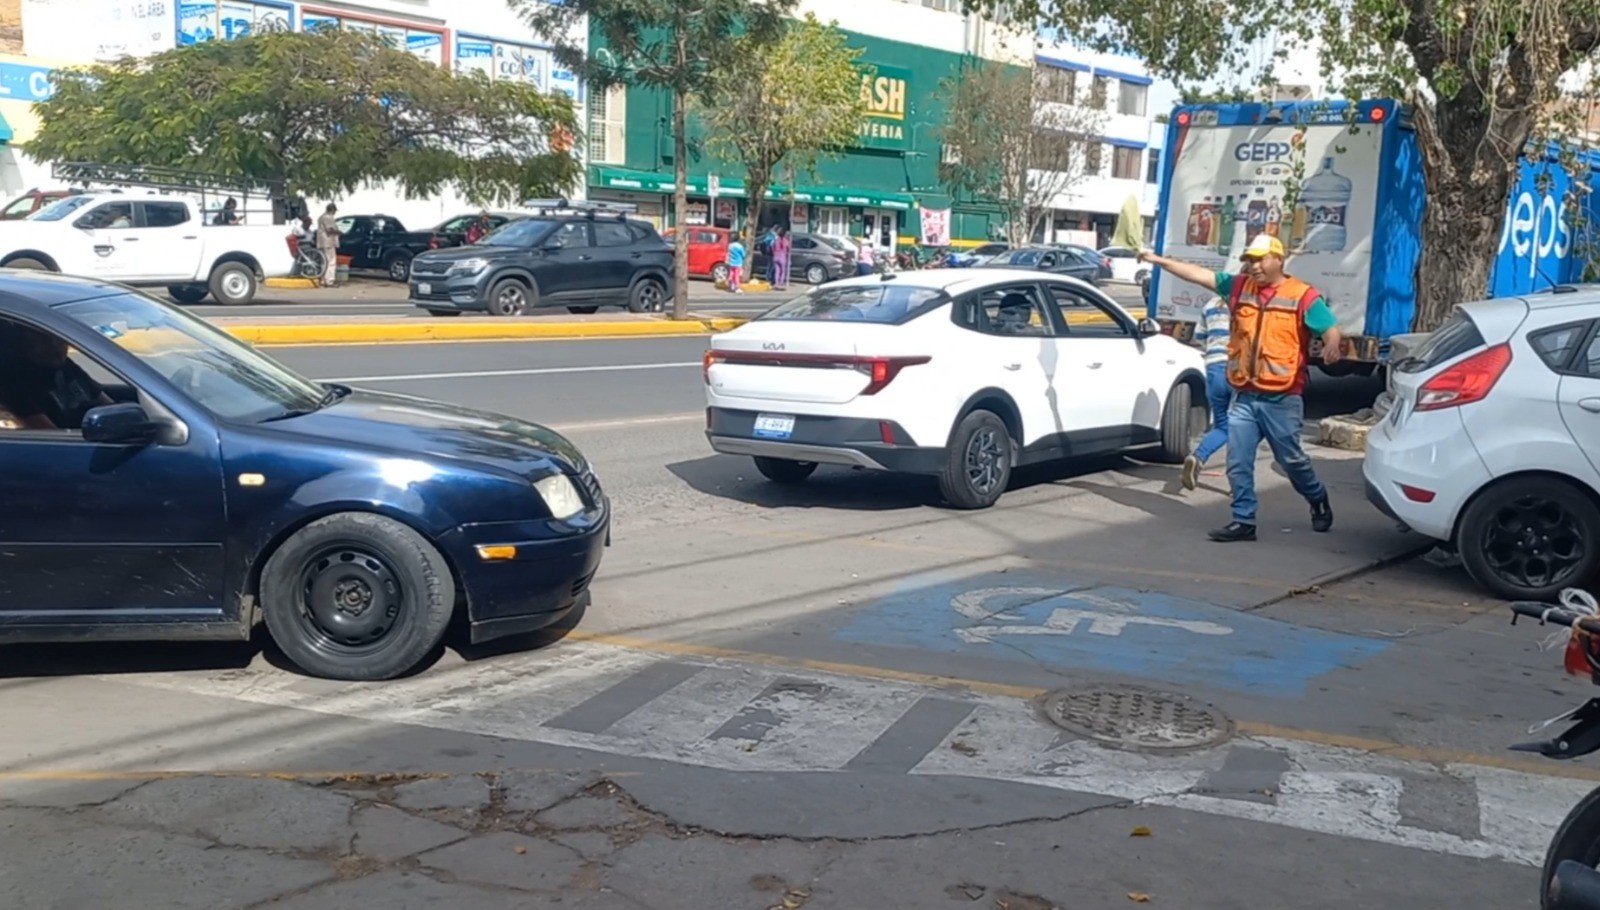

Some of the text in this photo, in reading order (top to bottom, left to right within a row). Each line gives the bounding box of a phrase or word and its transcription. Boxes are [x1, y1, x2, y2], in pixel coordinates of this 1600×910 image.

[859, 74, 906, 114] ASH
[1234, 142, 1291, 162] GEPP
[1498, 192, 1571, 278] eps
